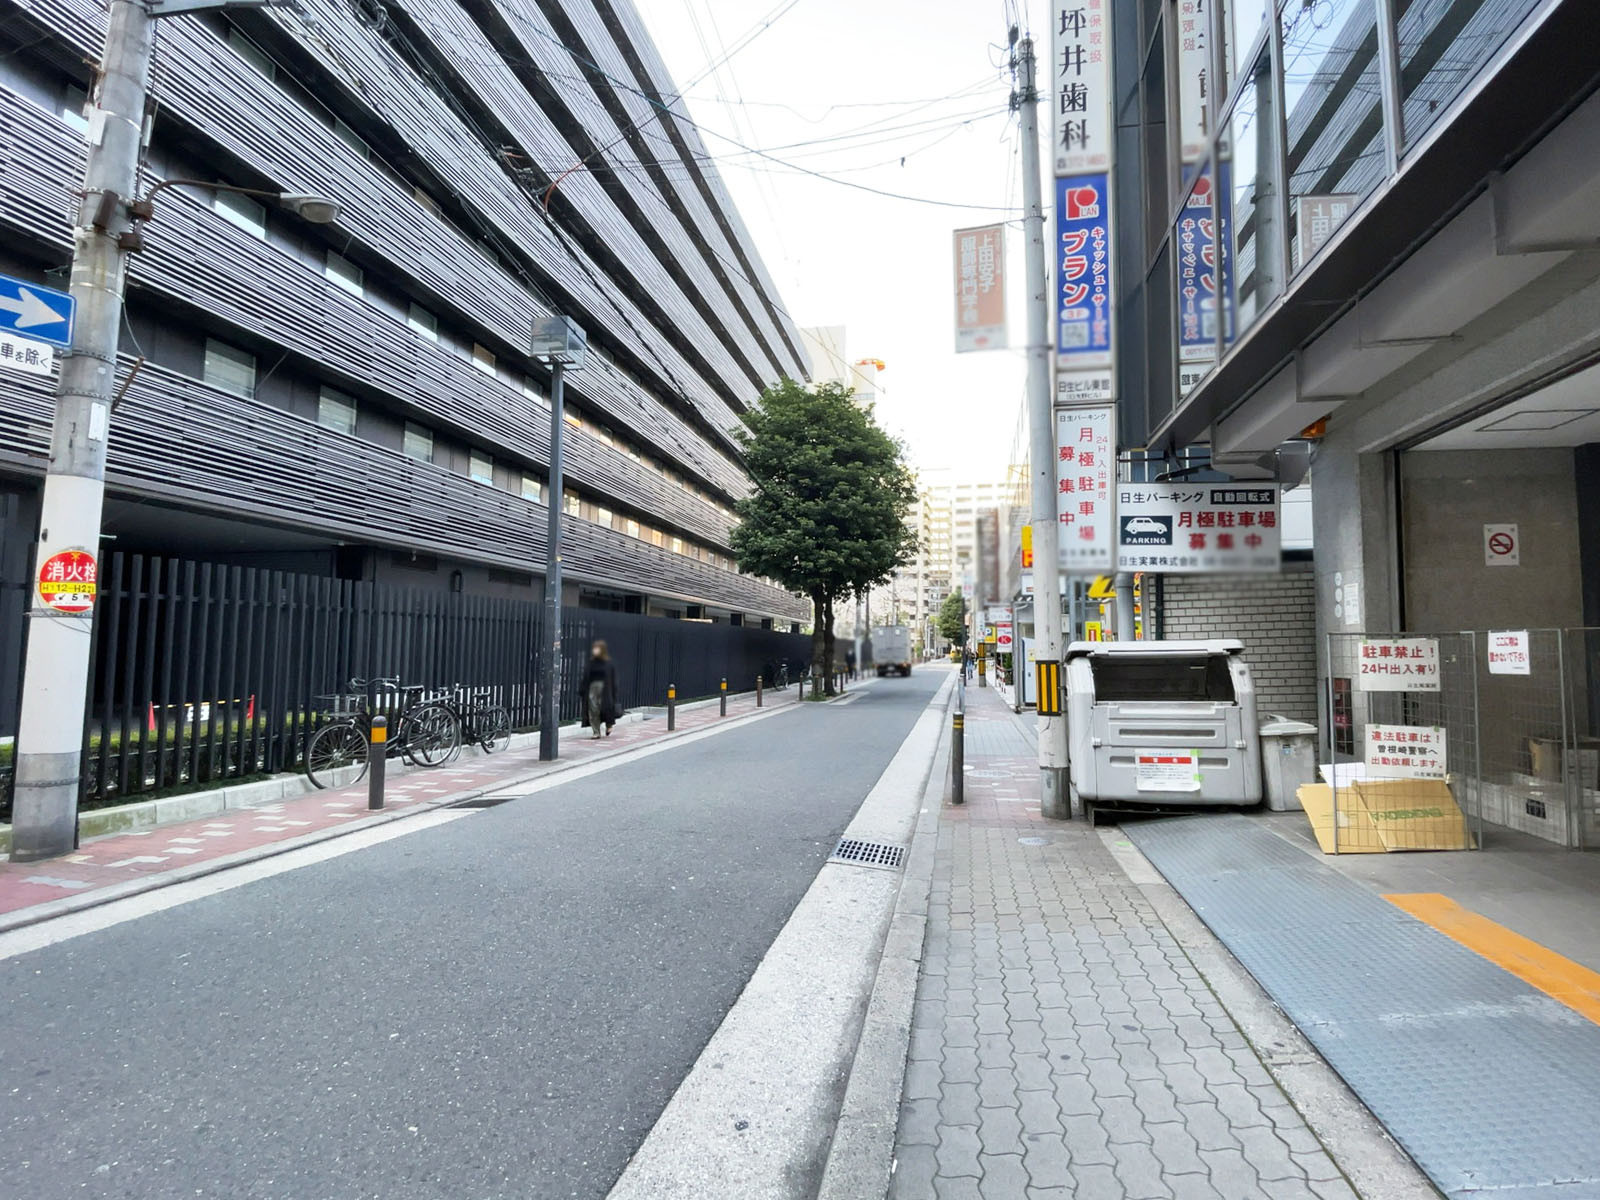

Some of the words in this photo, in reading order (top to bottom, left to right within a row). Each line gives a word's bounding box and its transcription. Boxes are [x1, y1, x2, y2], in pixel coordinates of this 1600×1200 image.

[1059, 7, 1090, 152] 坪井歯科
[1063, 229, 1089, 306] プラン
[1, 342, 49, 369] 車を除く
[1060, 414, 1106, 422] 日生パーキング
[1058, 446, 1075, 526] 募集中
[1078, 427, 1095, 541] 月極駐車場
[1121, 491, 1204, 504] 日生パーキング
[1213, 491, 1271, 503] 自動回転式
[1178, 511, 1276, 528] 月極駐車場
[1189, 532, 1263, 550] 募集中
[47, 561, 96, 582] 消火栓
[1361, 663, 1436, 675] 24H出入有り
